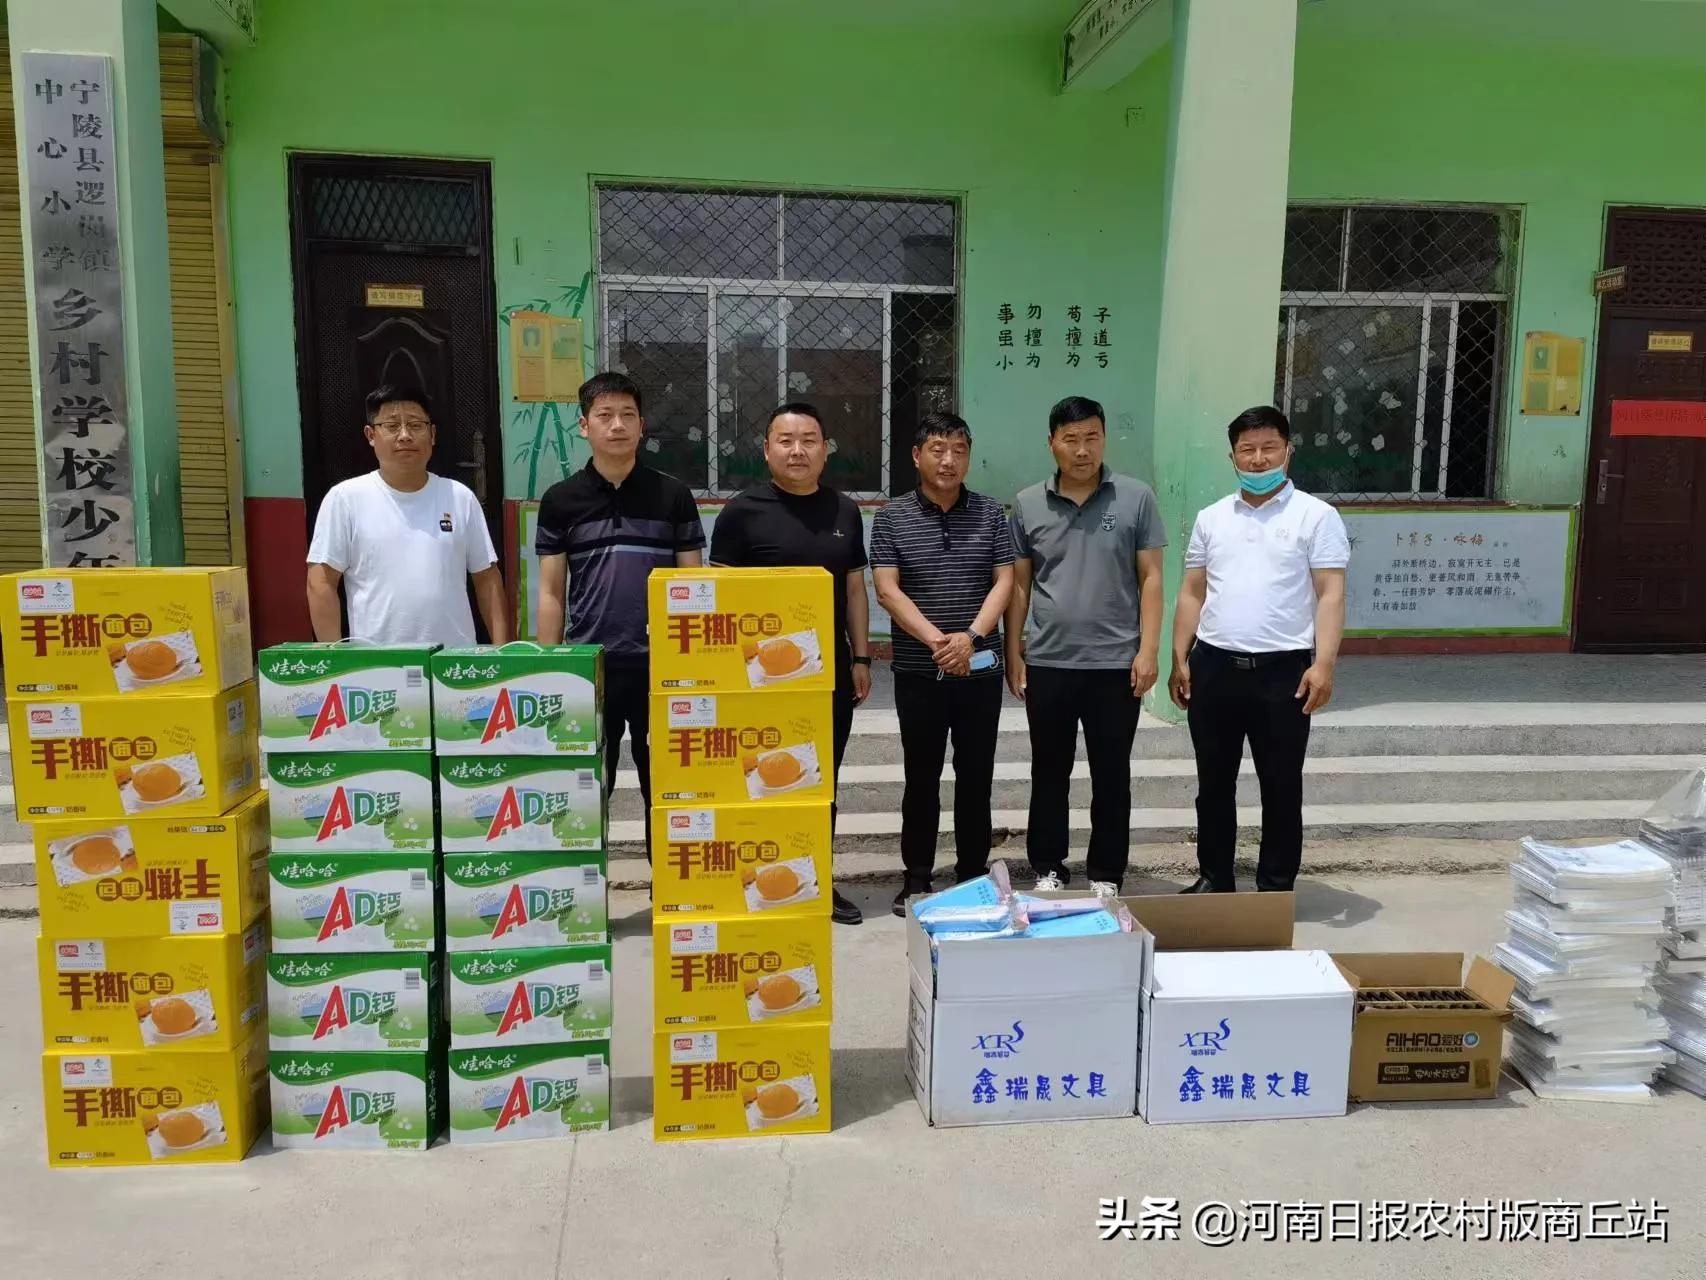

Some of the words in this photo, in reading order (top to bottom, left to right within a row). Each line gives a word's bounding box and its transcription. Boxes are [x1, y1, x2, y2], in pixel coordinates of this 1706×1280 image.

[35, 78, 75, 271] 中心小学
[995, 301, 1015, 371] 事虽小
[1024, 303, 1043, 368] 勿擅为
[1093, 307, 1112, 368] 子道亏
[21, 613, 153, 657] 手撕面包
[668, 613, 782, 654] 手撕面包
[269, 658, 329, 675] 娃哈哈
[443, 663, 499, 679] 娃哈哈
[31, 736, 158, 780] 手撕面包
[668, 727, 782, 767] 手撕面包
[277, 761, 335, 778] 娃哈哈
[449, 761, 505, 778] 娃哈哈
[279, 861, 337, 878] 娃哈哈
[454, 861, 512, 878] 娃哈哈
[668, 840, 780, 880] 手撕面包
[276, 960, 333, 977] 娃哈哈
[460, 958, 517, 976] 娃哈哈
[671, 951, 782, 992] 手撕面包
[58, 972, 174, 1010] 手撕面包
[278, 1059, 333, 1077] 娃哈哈
[459, 1054, 516, 1071] 娃哈哈
[671, 1060, 780, 1101] 手撕面包
[972, 1067, 1107, 1104] 鑫瑞晟文具
[1179, 1065, 1311, 1103] 鑫瑞晟文具
[63, 1086, 183, 1127] 手撕面包
